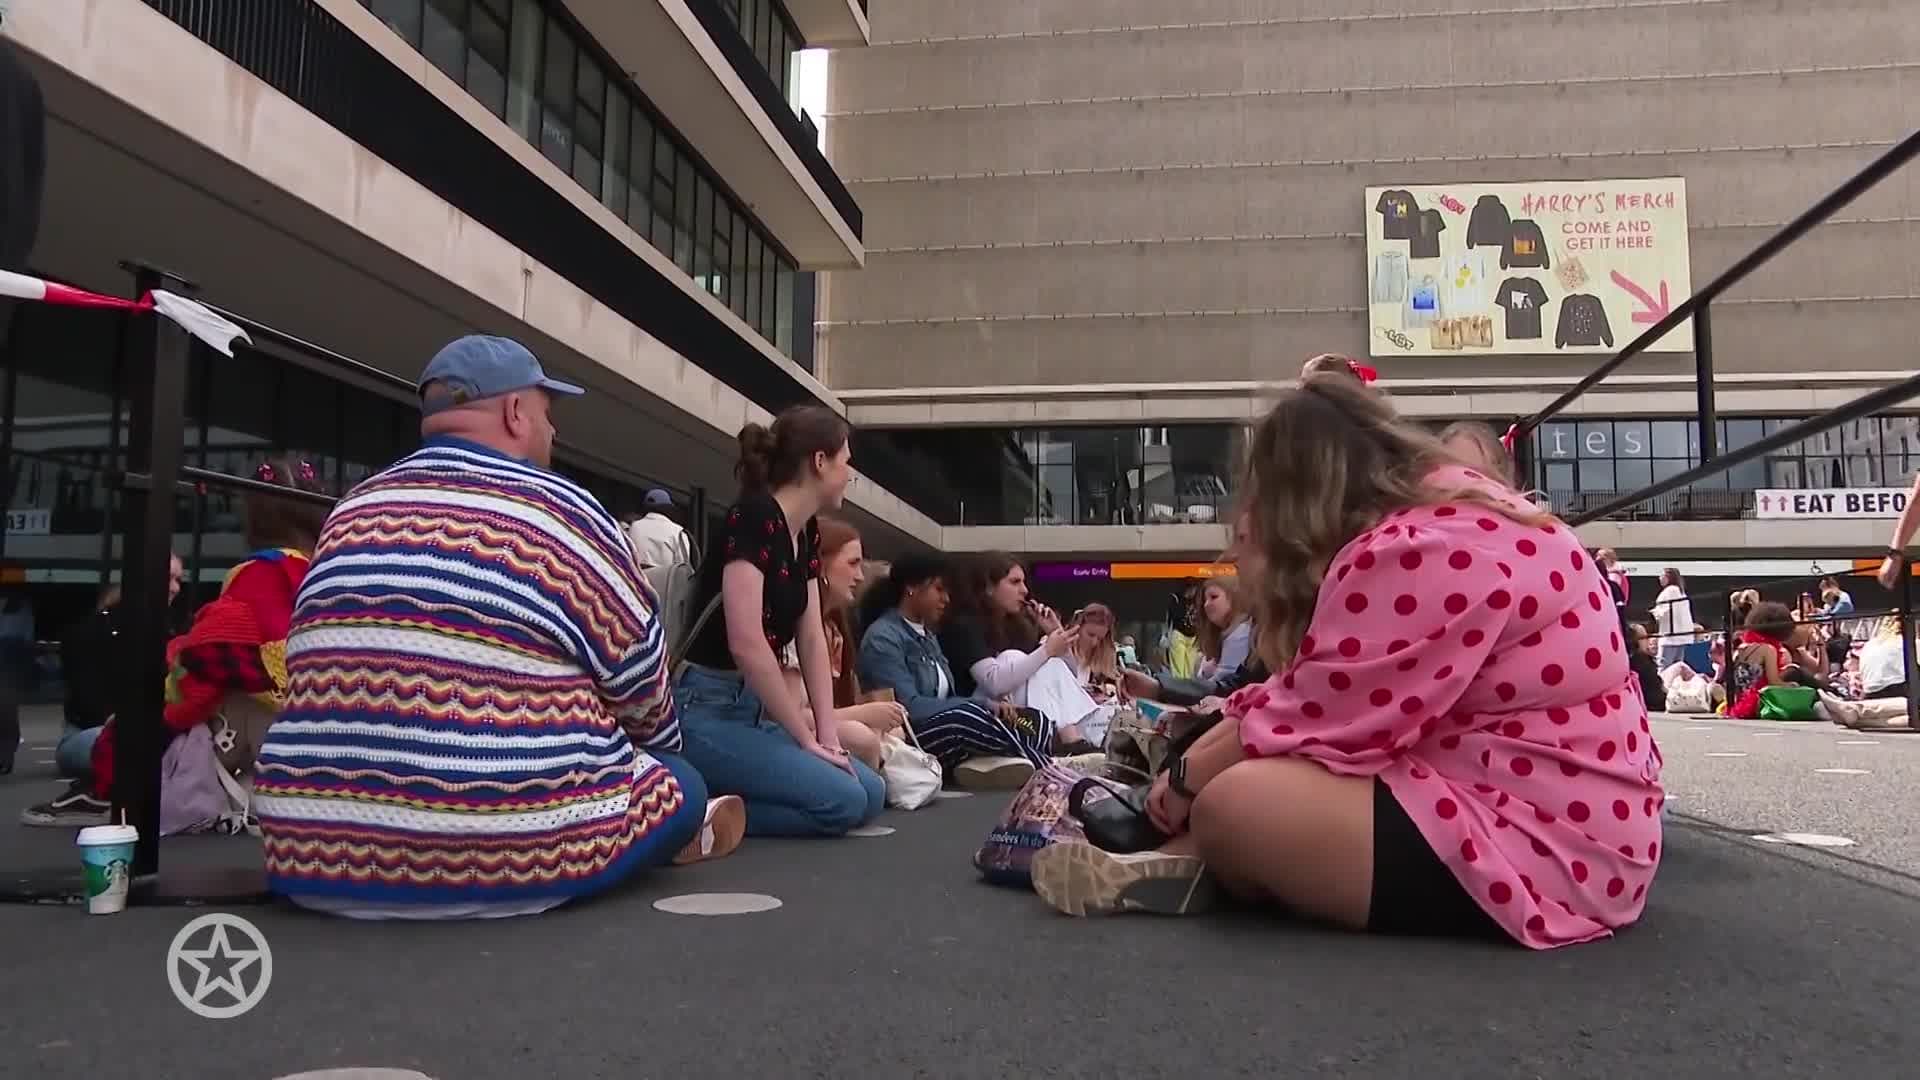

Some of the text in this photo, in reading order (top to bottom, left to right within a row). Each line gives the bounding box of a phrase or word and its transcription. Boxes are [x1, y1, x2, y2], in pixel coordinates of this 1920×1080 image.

[1521, 191, 1675, 216] HARRY'S MERCH
[1562, 220, 1651, 234] COME AND
[1566, 236, 1653, 250] GET IT HERE
[1793, 493, 1907, 513] EAT BEFO
